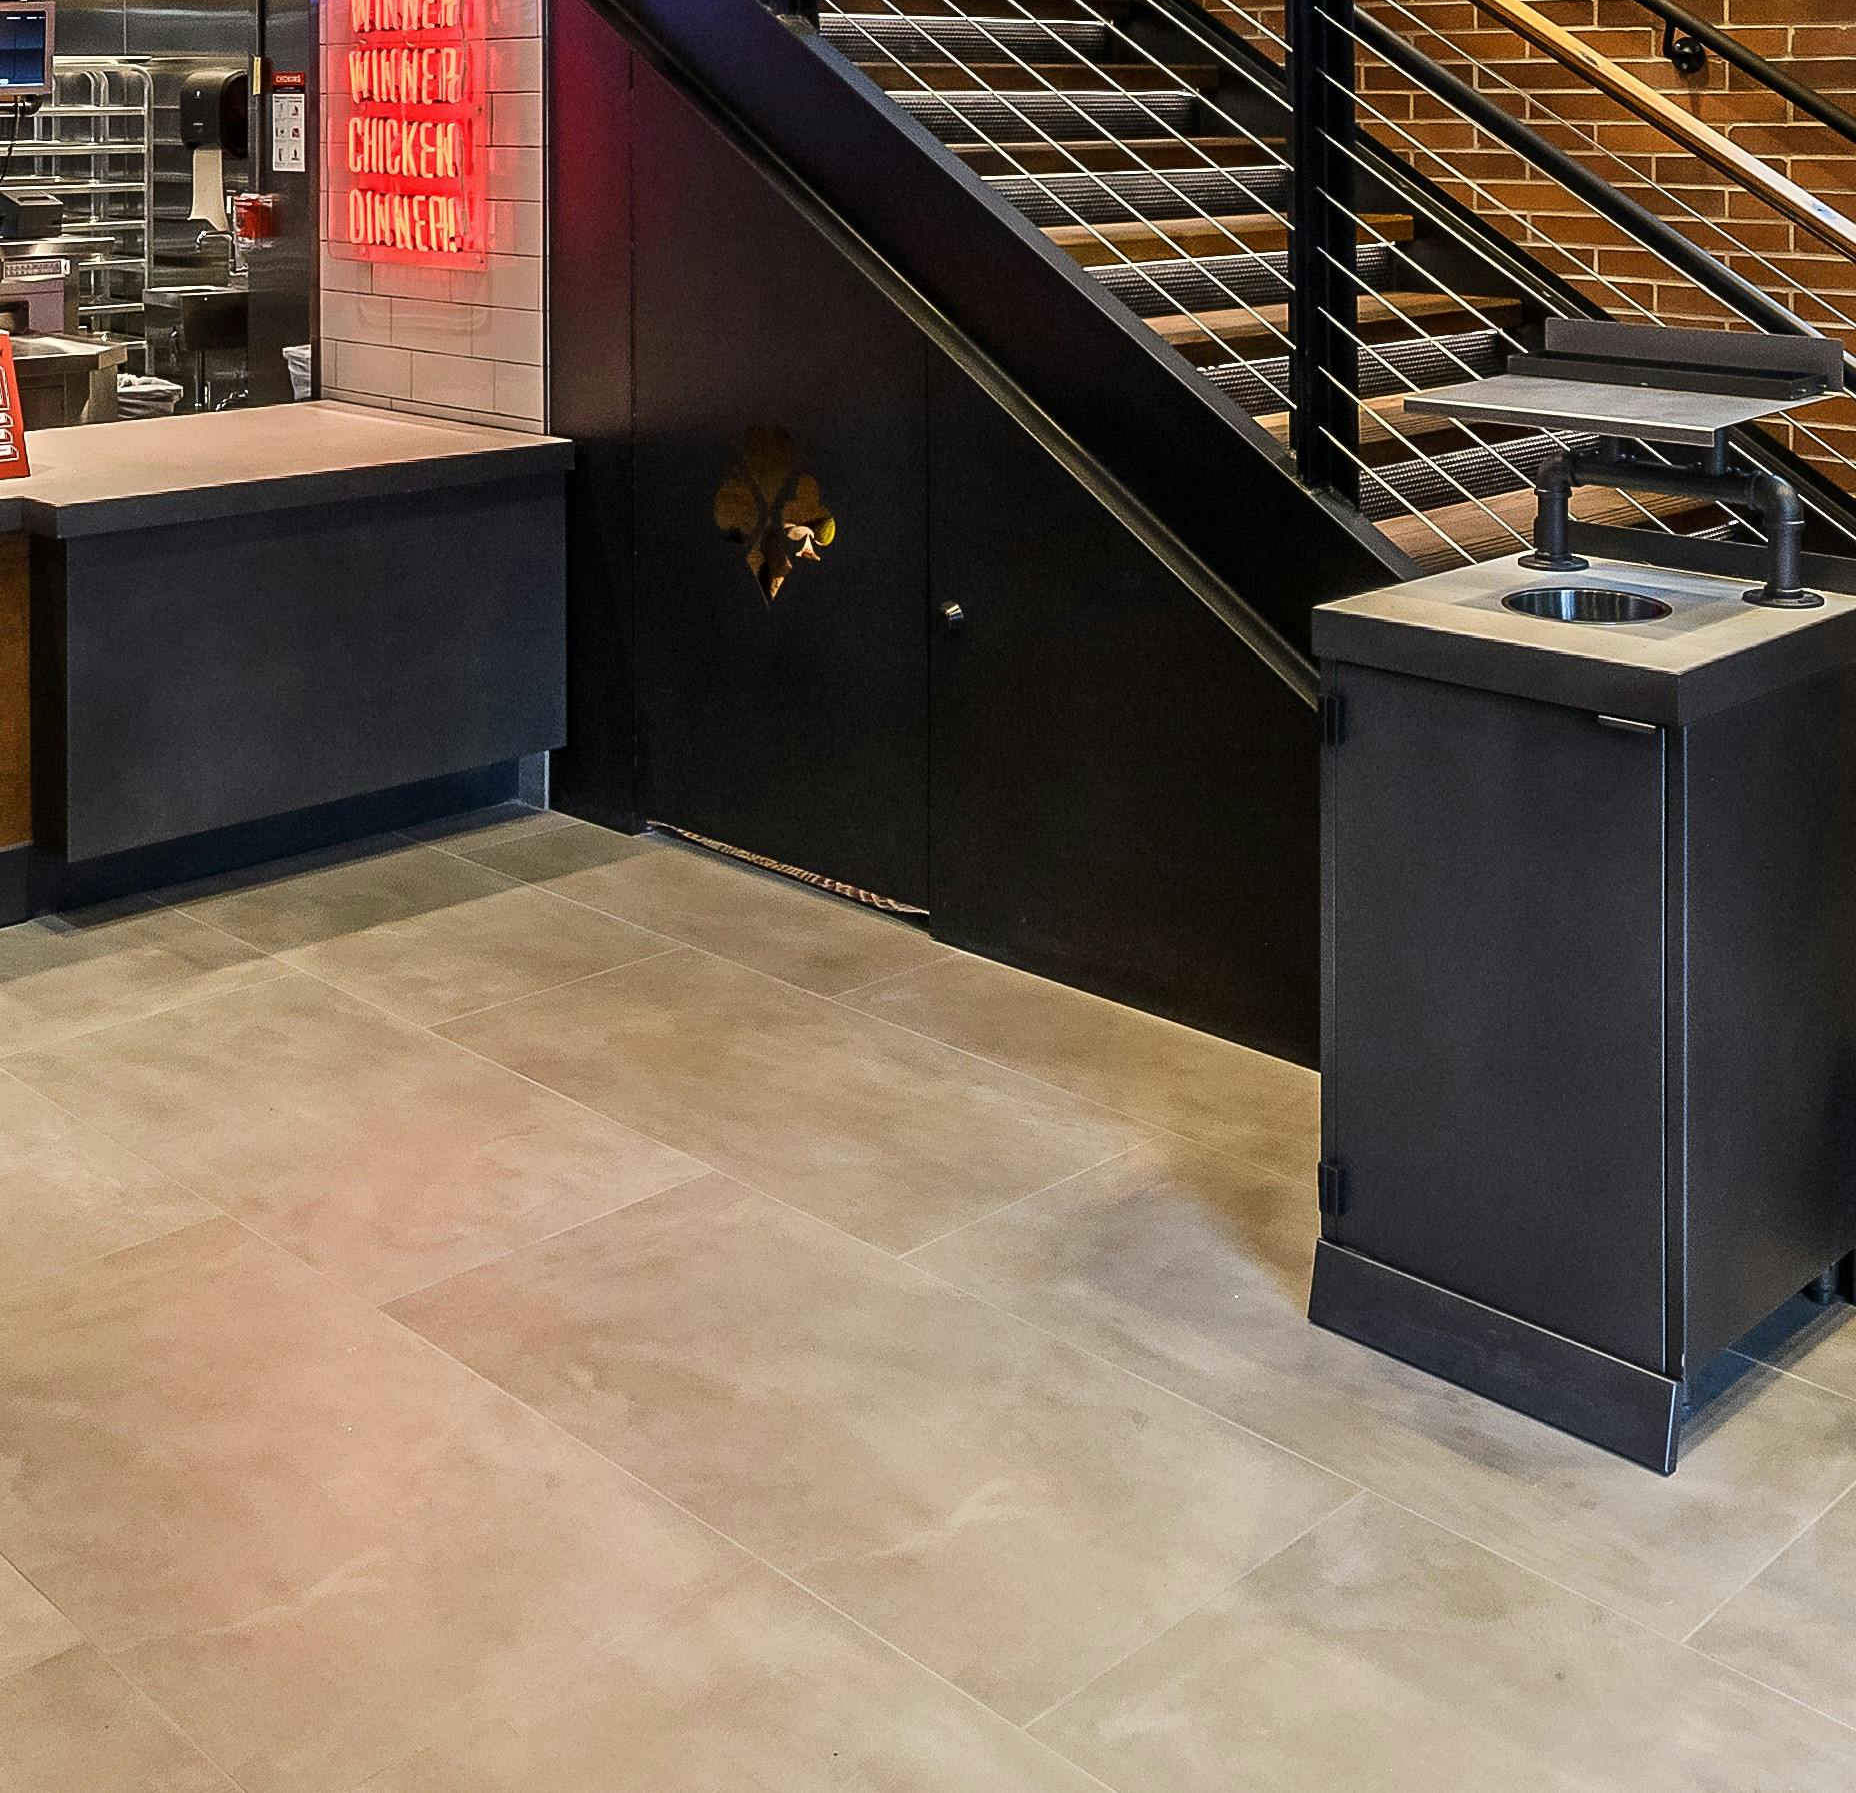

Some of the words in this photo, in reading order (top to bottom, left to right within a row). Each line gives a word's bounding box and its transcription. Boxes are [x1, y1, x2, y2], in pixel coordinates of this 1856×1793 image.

[349, 47, 462, 105] WINNER
[348, 116, 461, 179] CHICKEN
[348, 188, 464, 254] DINNER!
